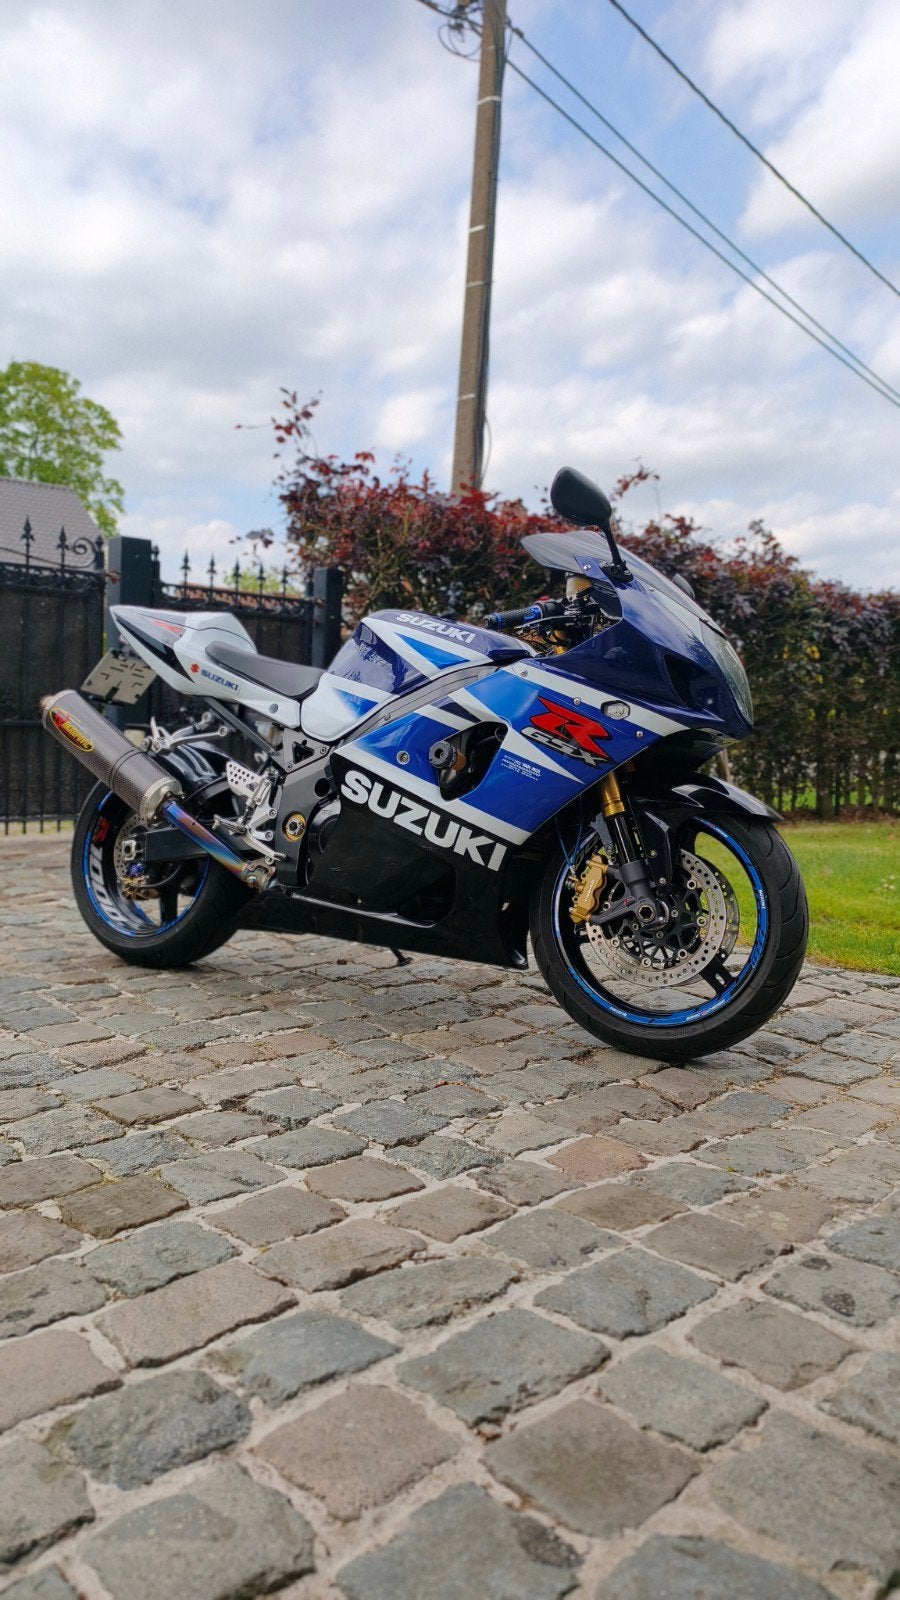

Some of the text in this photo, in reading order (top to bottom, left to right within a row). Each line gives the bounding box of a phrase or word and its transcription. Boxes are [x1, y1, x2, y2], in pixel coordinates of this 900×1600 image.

[396, 613, 476, 644] SUZUKI
[201, 669, 239, 691] SUZUKI
[521, 726, 608, 767] GSX
[341, 770, 507, 872] SUZUKI
